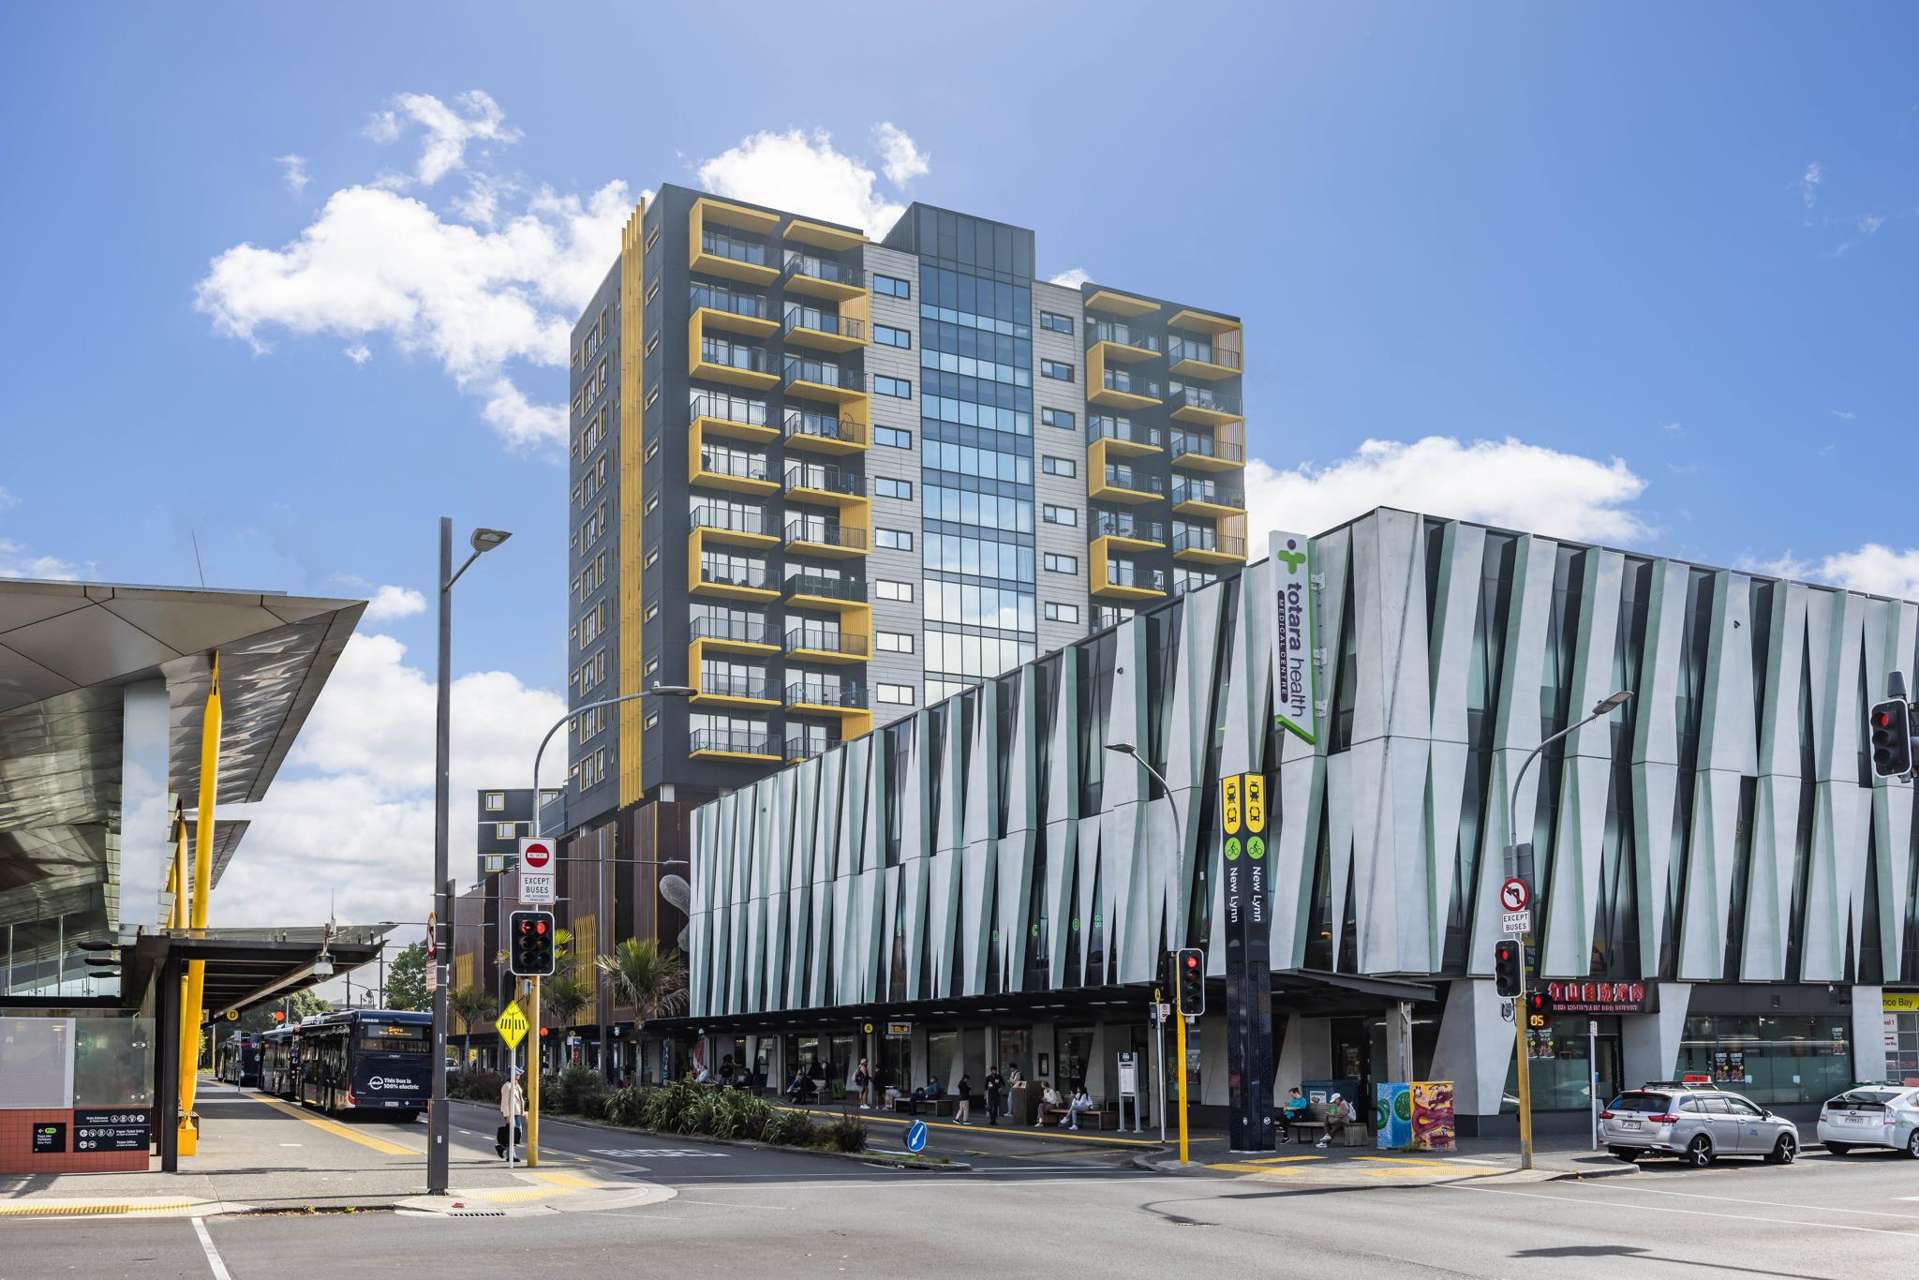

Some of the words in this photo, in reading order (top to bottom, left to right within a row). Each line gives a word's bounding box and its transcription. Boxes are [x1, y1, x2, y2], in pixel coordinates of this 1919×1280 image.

[1278, 599, 1286, 649] MEDICAL
[1287, 582, 1302, 651] totara
[1280, 651, 1288, 696] CENTRE
[1290, 657, 1306, 718] health
[524, 877, 550, 885] EXCEPT
[525, 886, 549, 894] BUSES
[1229, 866, 1239, 893] New
[1252, 866, 1262, 892] New
[1229, 895, 1239, 923] Lynn
[1252, 895, 1262, 922] Lynn
[1503, 913, 1528, 923] EXCEPT
[1505, 922, 1527, 931] BUSES
[1899, 998, 1913, 1008] Bay
[1530, 1014, 1544, 1026] 05
